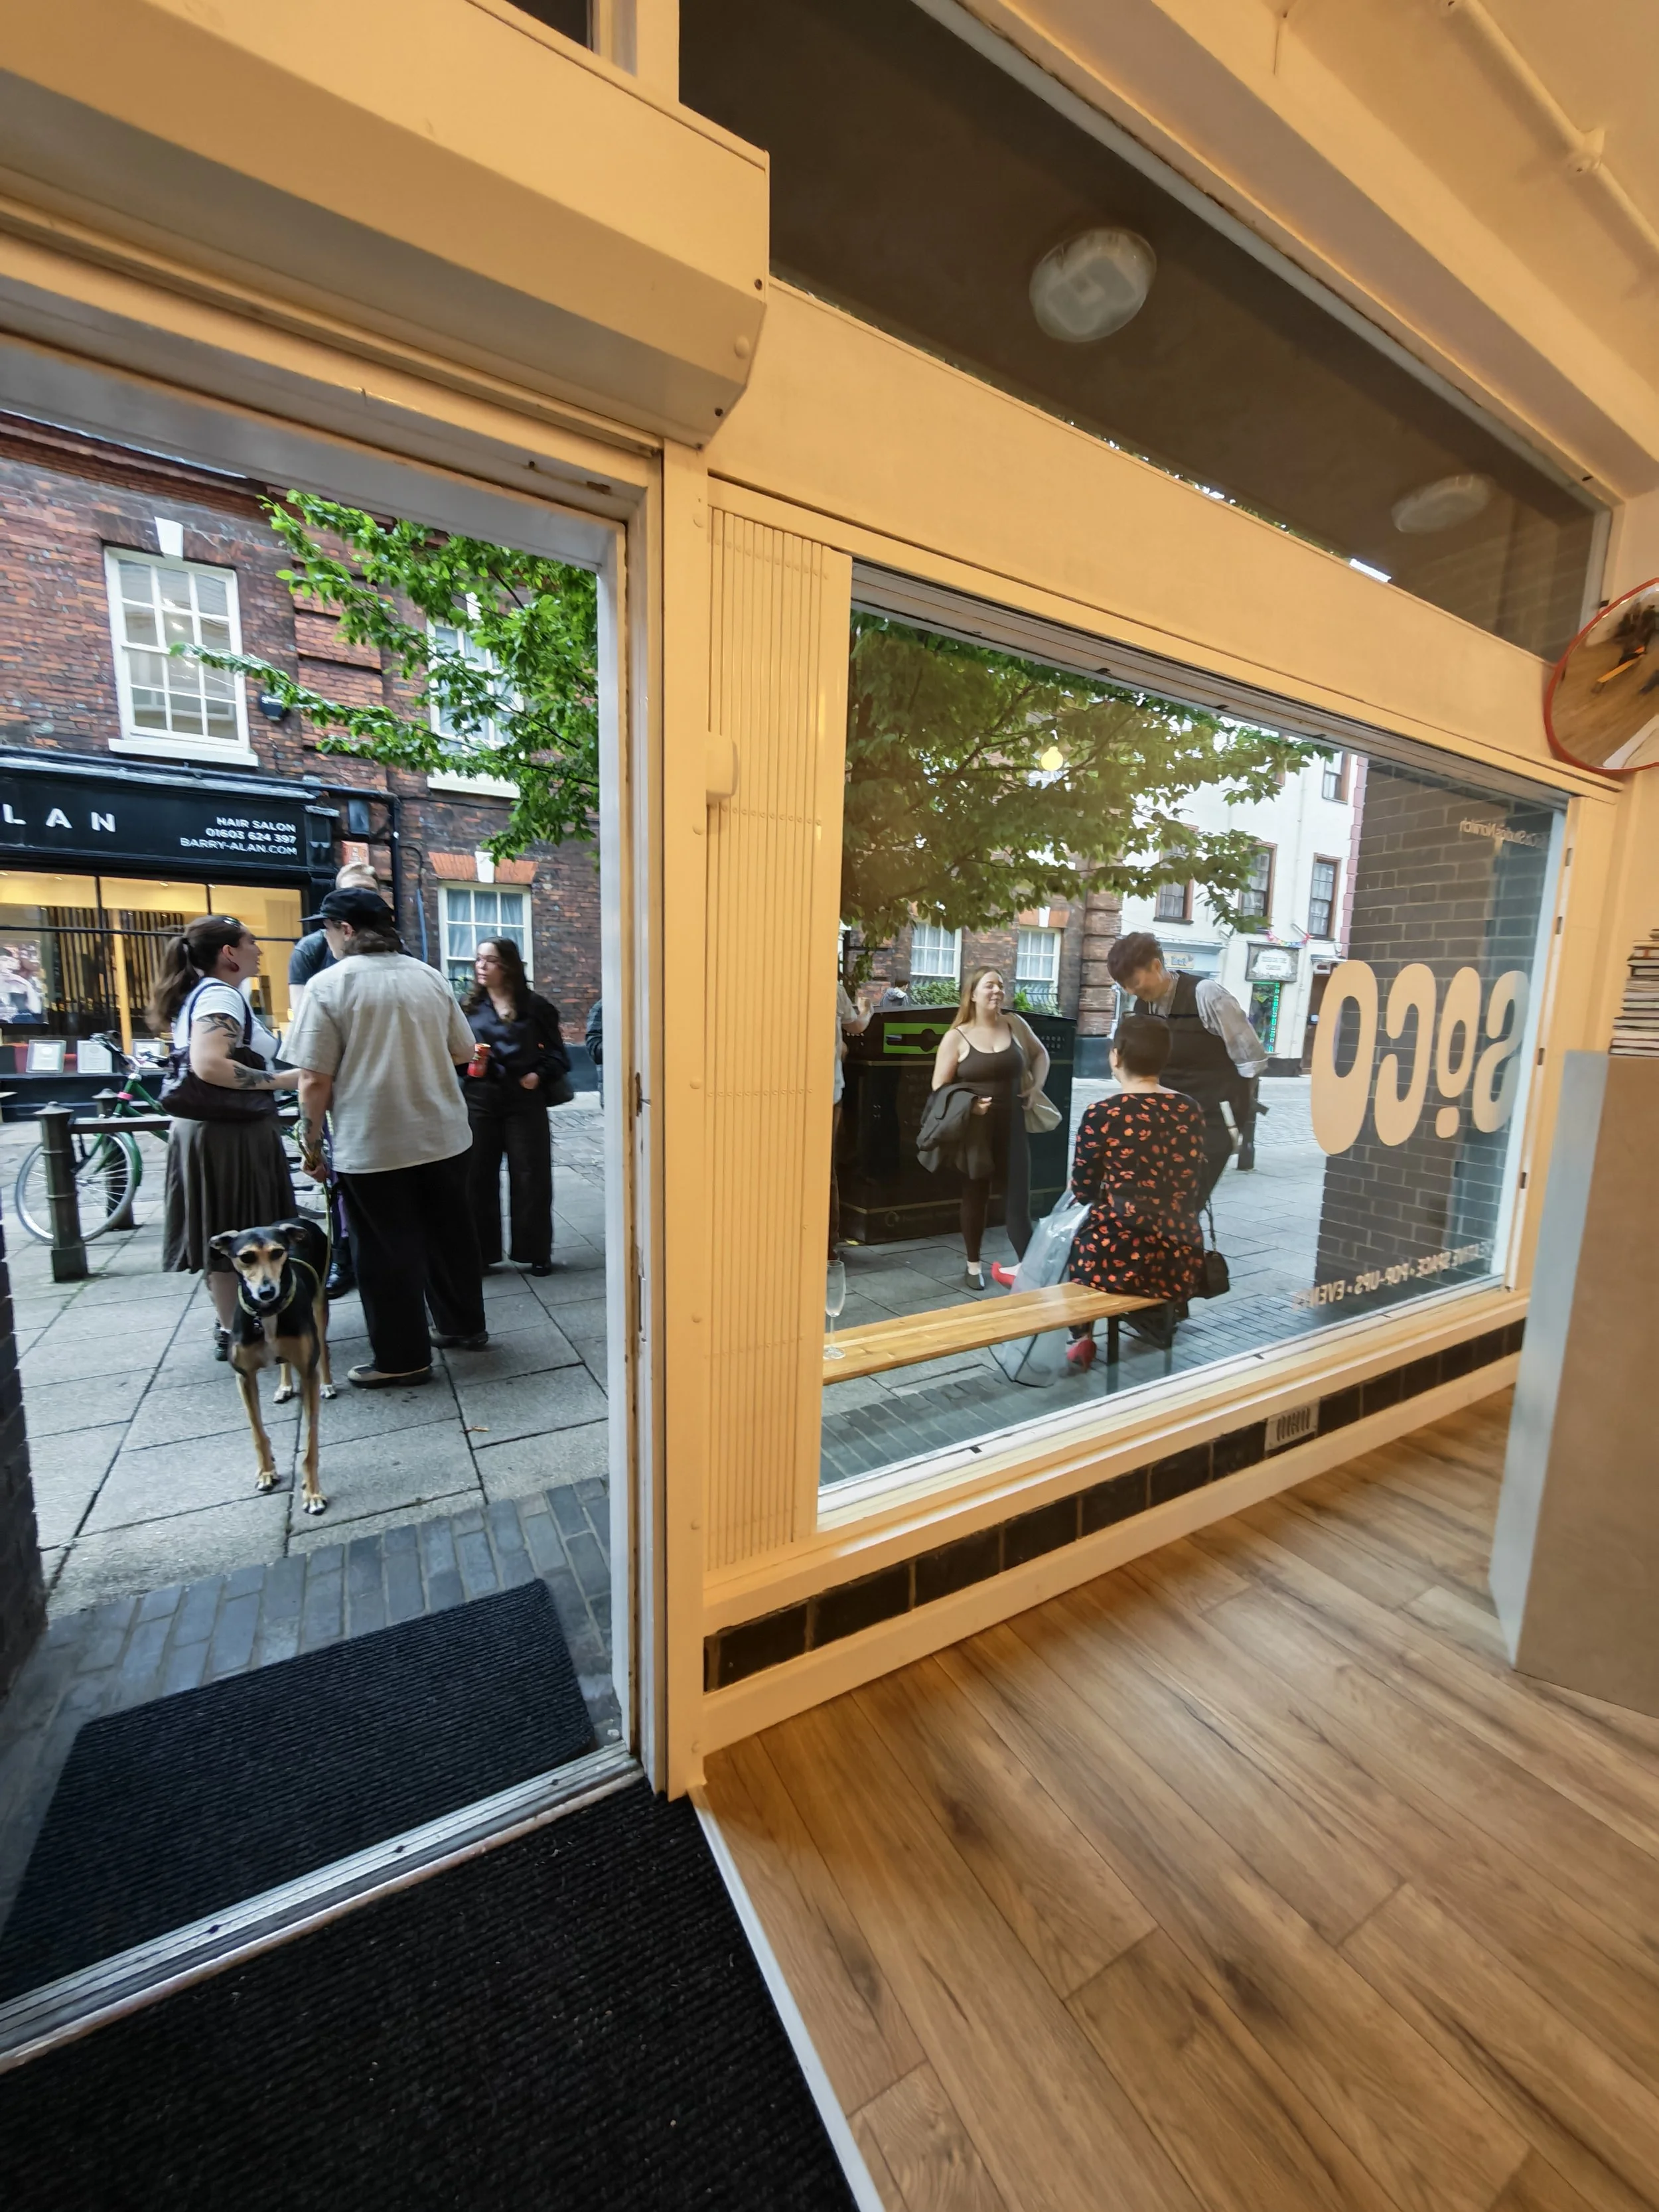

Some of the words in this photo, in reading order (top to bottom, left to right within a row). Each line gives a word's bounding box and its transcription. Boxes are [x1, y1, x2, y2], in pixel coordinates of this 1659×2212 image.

[3, 803, 116, 833] LAN
[216, 816, 250, 828] HAIR
[252, 820, 297, 833] SALON
[205, 828, 246, 840] 01603
[248, 831, 271, 842] 624
[273, 834, 297, 844] 397
[180, 837, 298, 855] BARRY-ALAN.COM
